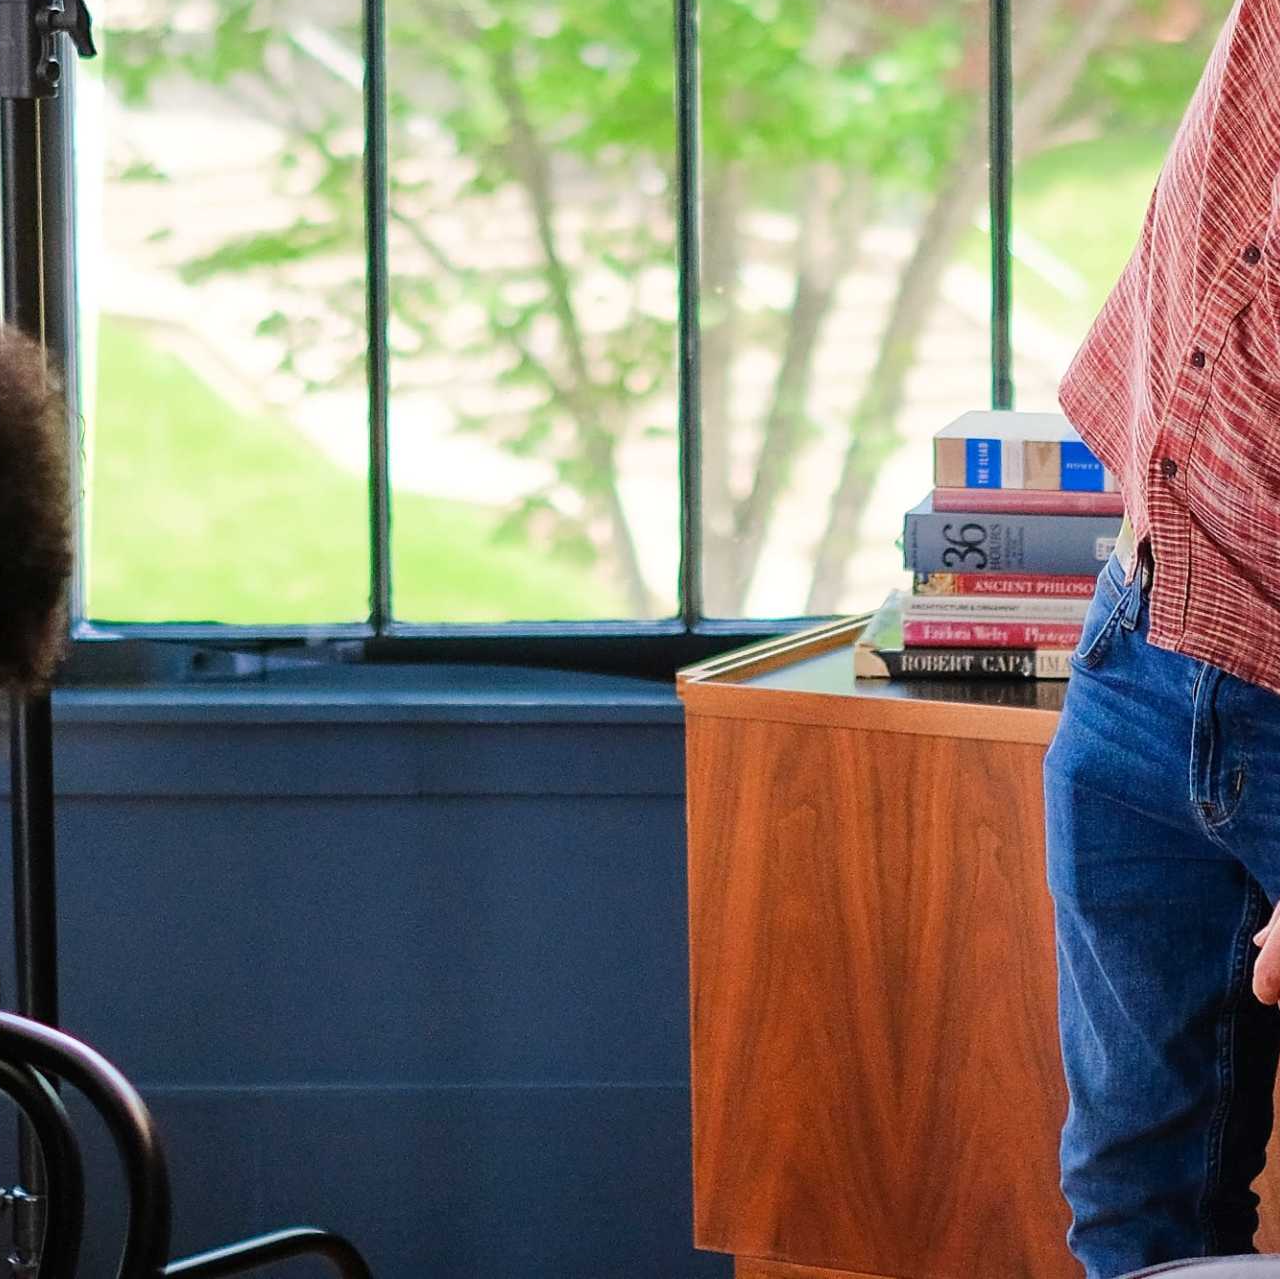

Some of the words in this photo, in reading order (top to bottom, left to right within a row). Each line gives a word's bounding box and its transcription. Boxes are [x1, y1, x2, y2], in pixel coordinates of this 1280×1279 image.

[941, 522, 988, 570] 36
[989, 523, 1002, 570] HOURS
[974, 580, 1033, 593] ANCIENT
[1036, 582, 1095, 594] PHILOSO
[901, 654, 974, 672] ROBERT
[982, 655, 1033, 672] CAPA
